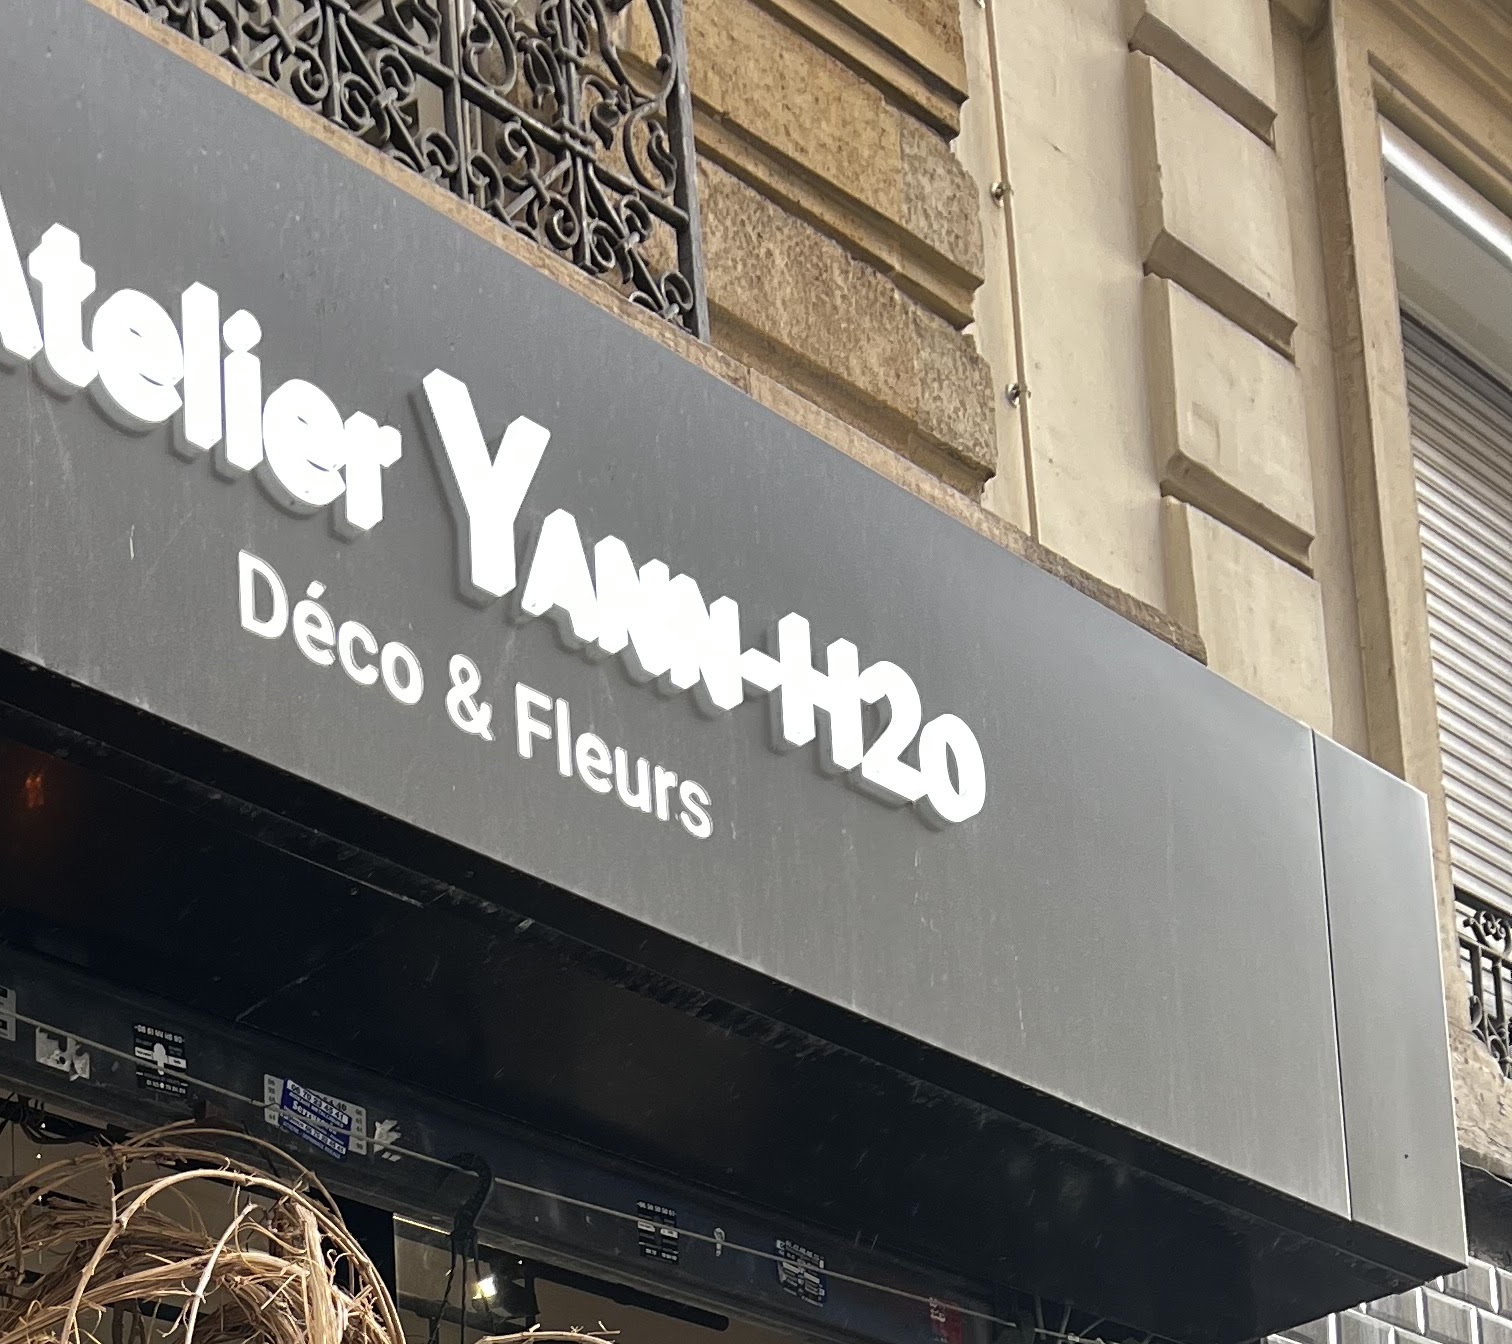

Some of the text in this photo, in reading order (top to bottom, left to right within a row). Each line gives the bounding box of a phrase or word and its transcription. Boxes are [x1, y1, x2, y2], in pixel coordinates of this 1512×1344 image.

[237, 550, 714, 841] Déco & Fleurs
